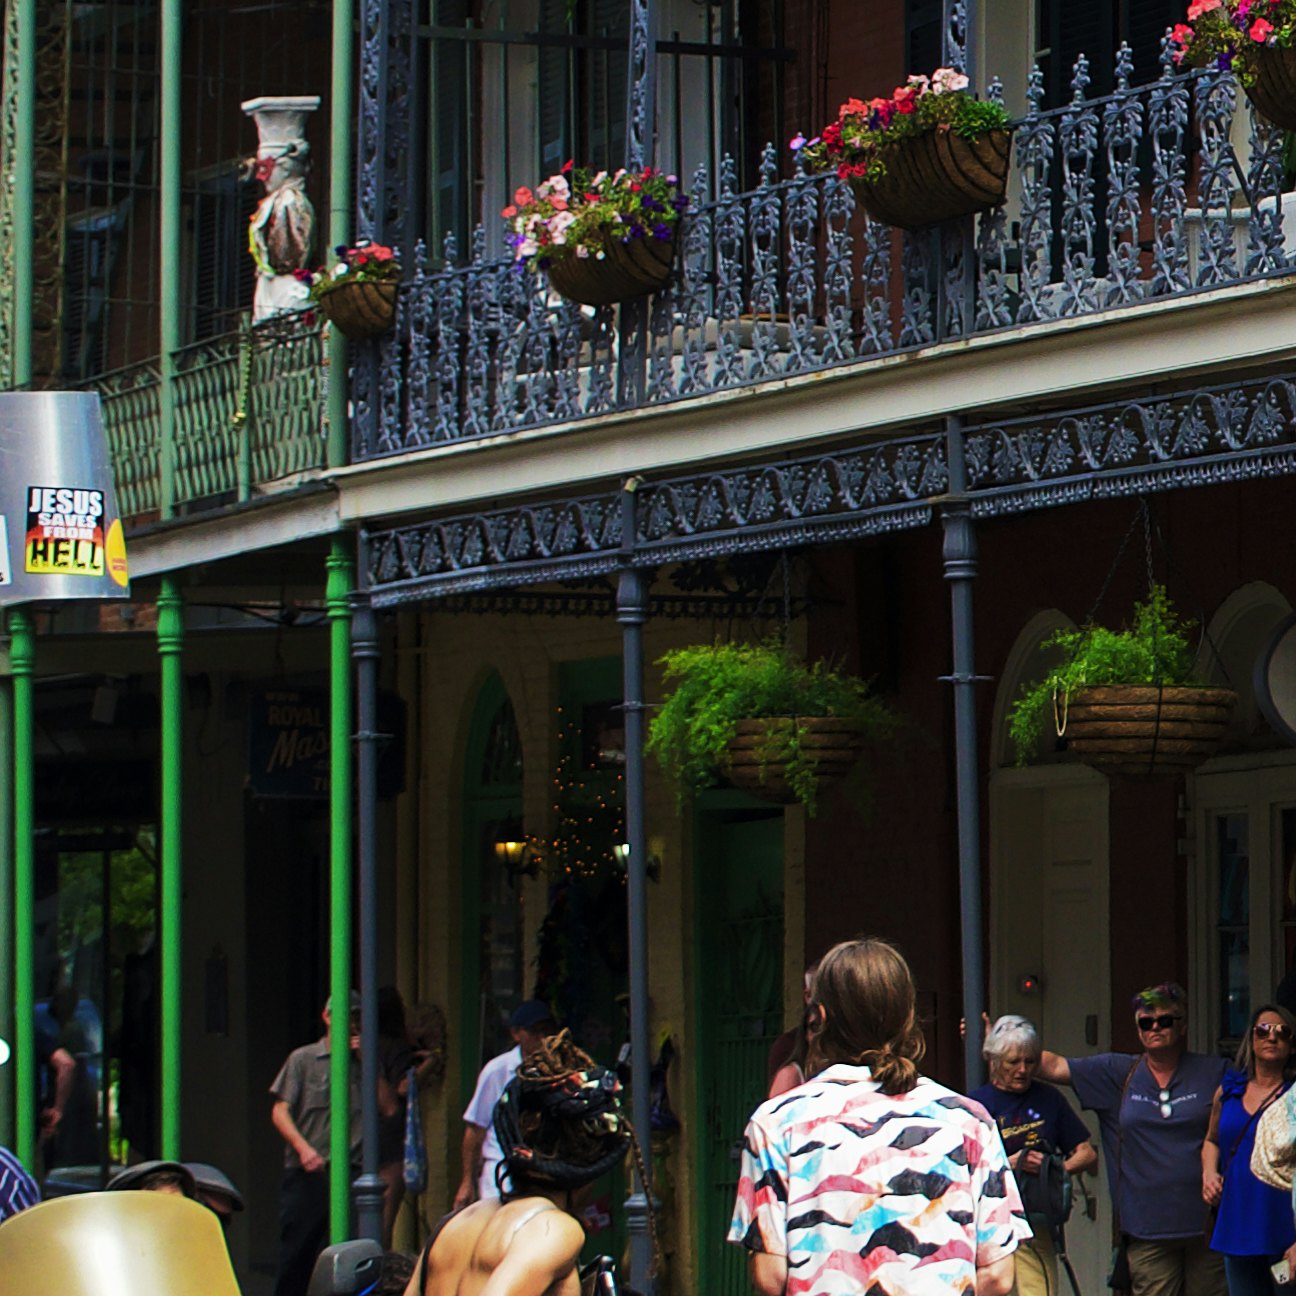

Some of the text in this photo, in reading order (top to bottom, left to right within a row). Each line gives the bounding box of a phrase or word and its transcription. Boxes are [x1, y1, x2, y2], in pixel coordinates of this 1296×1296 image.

[28, 487, 103, 517] JESUS
[37, 511, 98, 529] SAVES
[42, 526, 94, 540] FROM
[30, 537, 103, 570] HELL
[267, 705, 324, 728] ROYAL
